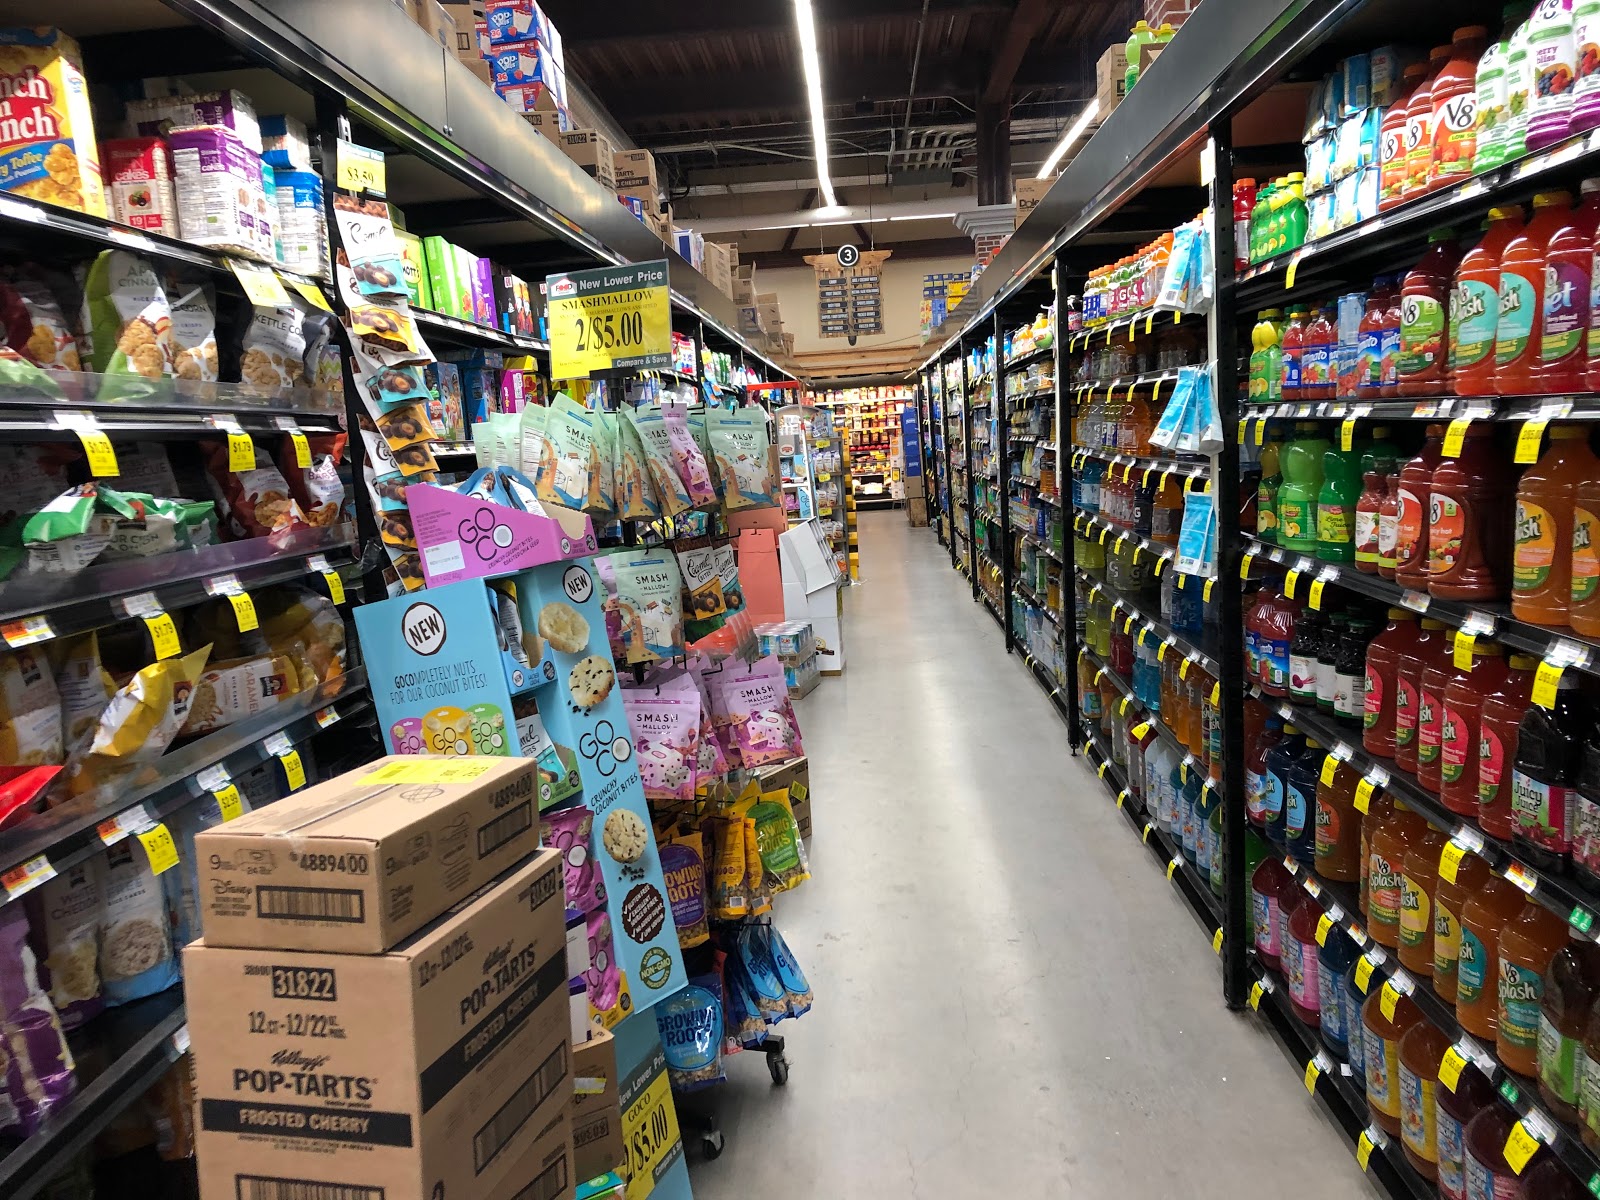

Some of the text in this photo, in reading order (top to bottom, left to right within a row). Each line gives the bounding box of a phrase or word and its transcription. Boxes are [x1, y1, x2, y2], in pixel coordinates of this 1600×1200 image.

[491, 30, 501, 38] 36
[497, 73, 507, 81] 36
[1446, 97, 1474, 129] V8
[11, 152, 43, 169] Toffee
[201, 163, 225, 172] cakes
[115, 168, 150, 180] cakes
[131, 216, 143, 226] 19
[844, 249, 853, 262] 3
[118, 277, 160, 288] CINNA
[580, 270, 663, 290] New Lower Price
[562, 290, 654, 311] SMASHMALLOW
[1120, 290, 1127, 301] G
[180, 304, 206, 313] CORN
[1403, 298, 1417, 323] V8
[254, 314, 287, 331] KETTLE
[575, 311, 643, 352] 2/$5.00
[616, 359, 643, 367] Compare
[652, 356, 668, 364] Save
[566, 425, 592, 443] SMAS
[570, 436, 590, 449] MALLO
[233, 441, 251, 453] $1.79
[1134, 507, 1141, 517] G
[1326, 515, 1343, 524] Lime
[1443, 527, 1452, 535] hot
[521, 536, 533, 547] BITES
[567, 574, 588, 595] NEW
[635, 573, 668, 585] SMASH
[154, 621, 173, 638] $1.79
[408, 613, 441, 647] NEW
[395, 660, 476, 689] GOCOMPLETELY NUTS
[245, 664, 258, 713] CARAMEL
[390, 674, 488, 705] FOR OUR COCONUT BITES!
[740, 685, 775, 698] SMASH
[747, 693, 773, 704] MALLOW
[636, 713, 679, 722] SMASH
[221, 792, 238, 809] $2.99
[542, 785, 550, 799] NEW
[590, 777, 618, 807] CRUNCHY
[595, 771, 639, 816] COCONUT BITES
[1515, 781, 1542, 806] Juicy
[1516, 795, 1539, 812] Juice
[759, 818, 790, 841] OWING
[210, 854, 221, 870] 9
[1377, 857, 1389, 874] V8
[665, 863, 702, 888] OWING
[669, 880, 702, 904] OOTS
[641, 957, 670, 979] NON-GMO
[1504, 963, 1519, 983] V8
[275, 969, 334, 998] 31822
[460, 943, 535, 1025] POP-TARTS
[233, 1068, 372, 1100] POP-TARTS
[632, 1065, 652, 1090] Lower
[628, 1093, 651, 1123] GOCO
[239, 1109, 370, 1134] FROSTED CHERRY
[624, 1103, 668, 1184] 2/$5.00
[1511, 1131, 1534, 1155] $4.99
